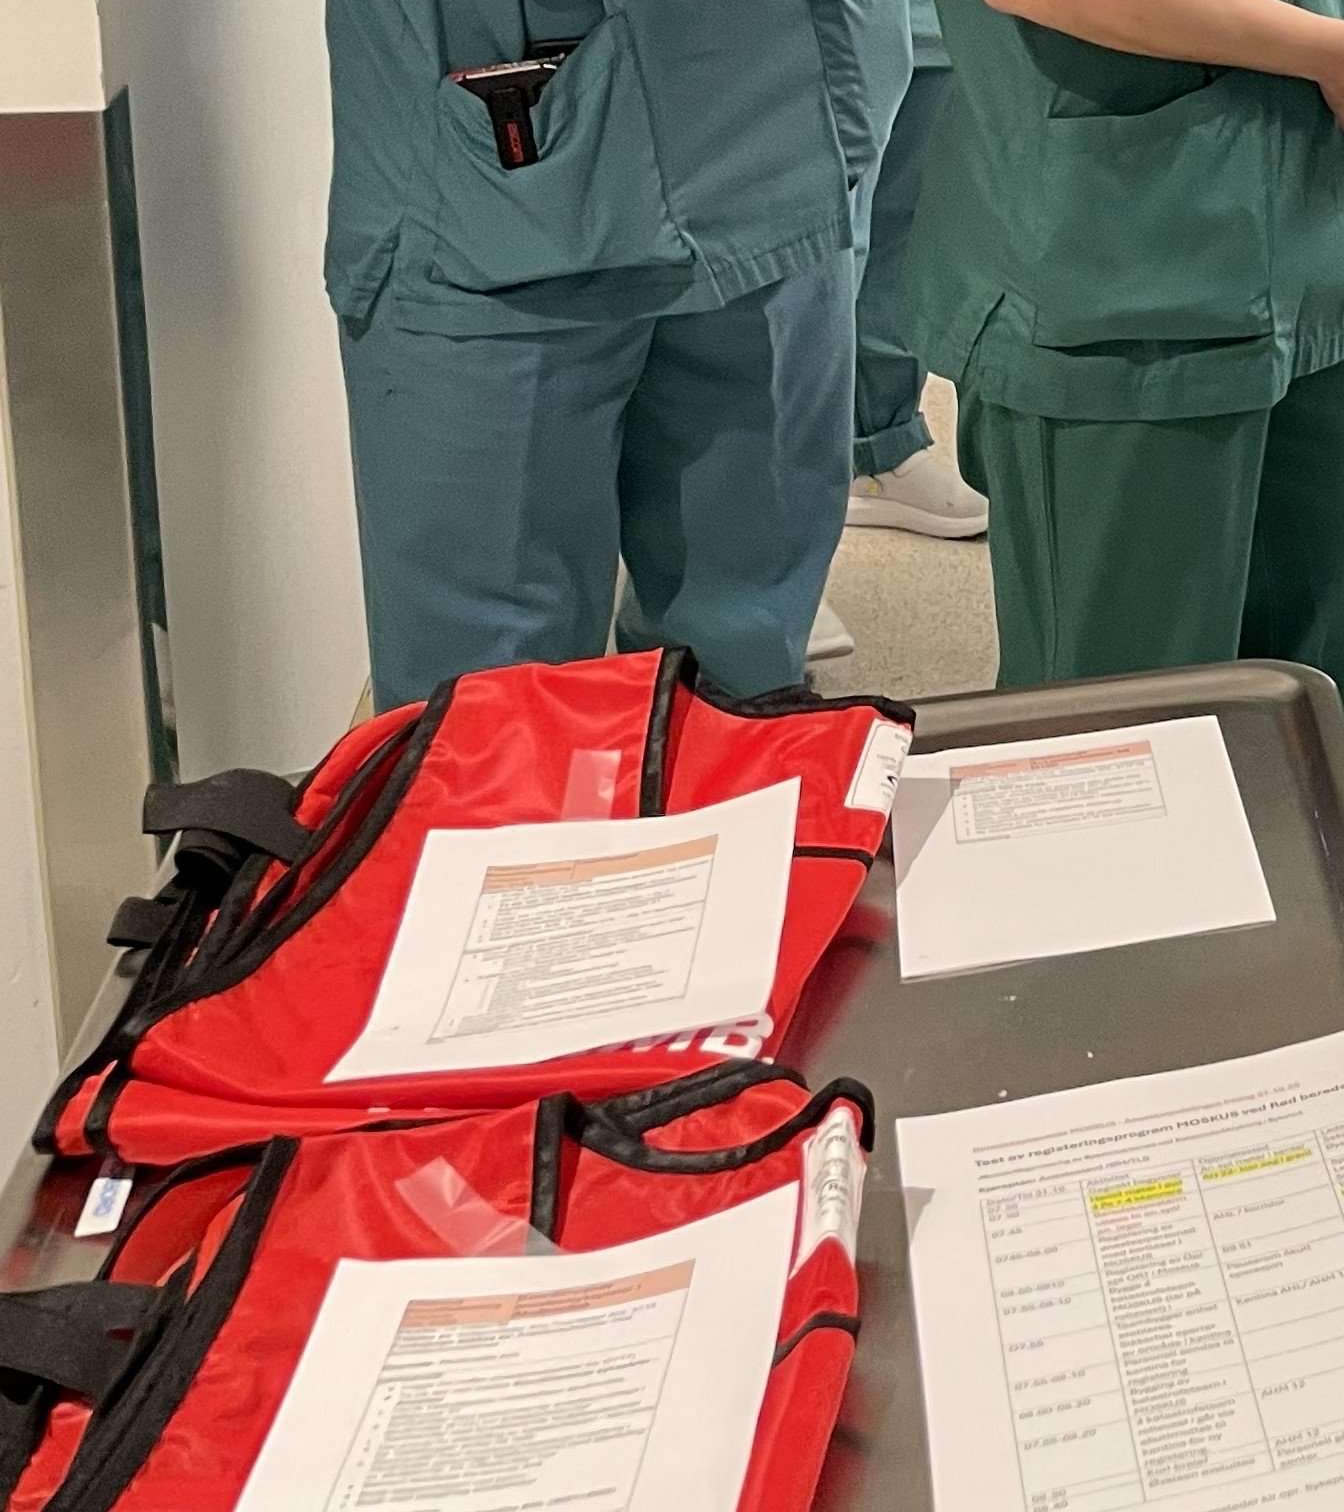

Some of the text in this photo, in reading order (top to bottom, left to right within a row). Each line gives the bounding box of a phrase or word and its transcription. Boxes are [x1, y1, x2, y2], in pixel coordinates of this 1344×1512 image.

[975, 1156, 1004, 1167] Test
[1008, 1153, 1024, 1161] av
[1175, 1109, 1238, 1129] MOSKUS
[1241, 1103, 1266, 1115] ved
